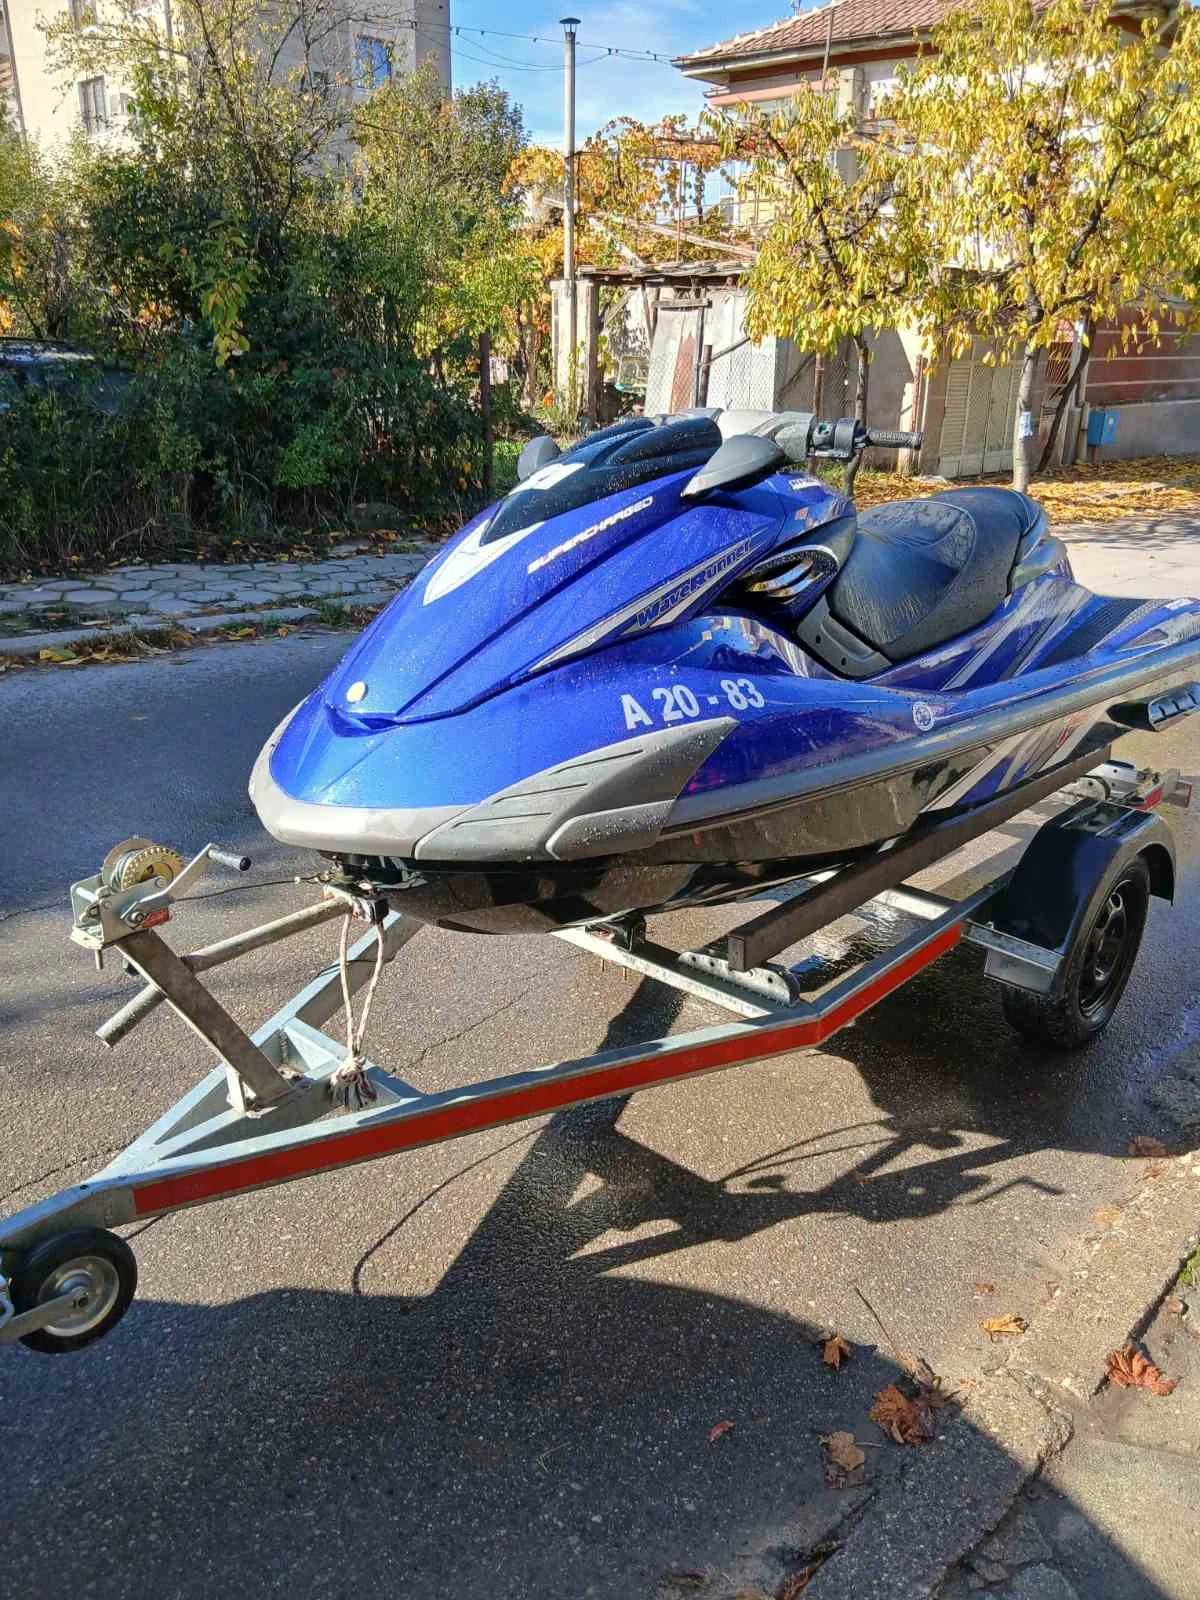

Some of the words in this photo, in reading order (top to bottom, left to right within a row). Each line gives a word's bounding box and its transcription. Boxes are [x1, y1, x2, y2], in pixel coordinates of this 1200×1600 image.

[527, 496, 653, 574] SUPERCHARGED
[636, 537, 752, 628] WaveRunner
[621, 694, 653, 730] A
[652, 684, 699, 722] 20
[720, 678, 765, 710] 83
